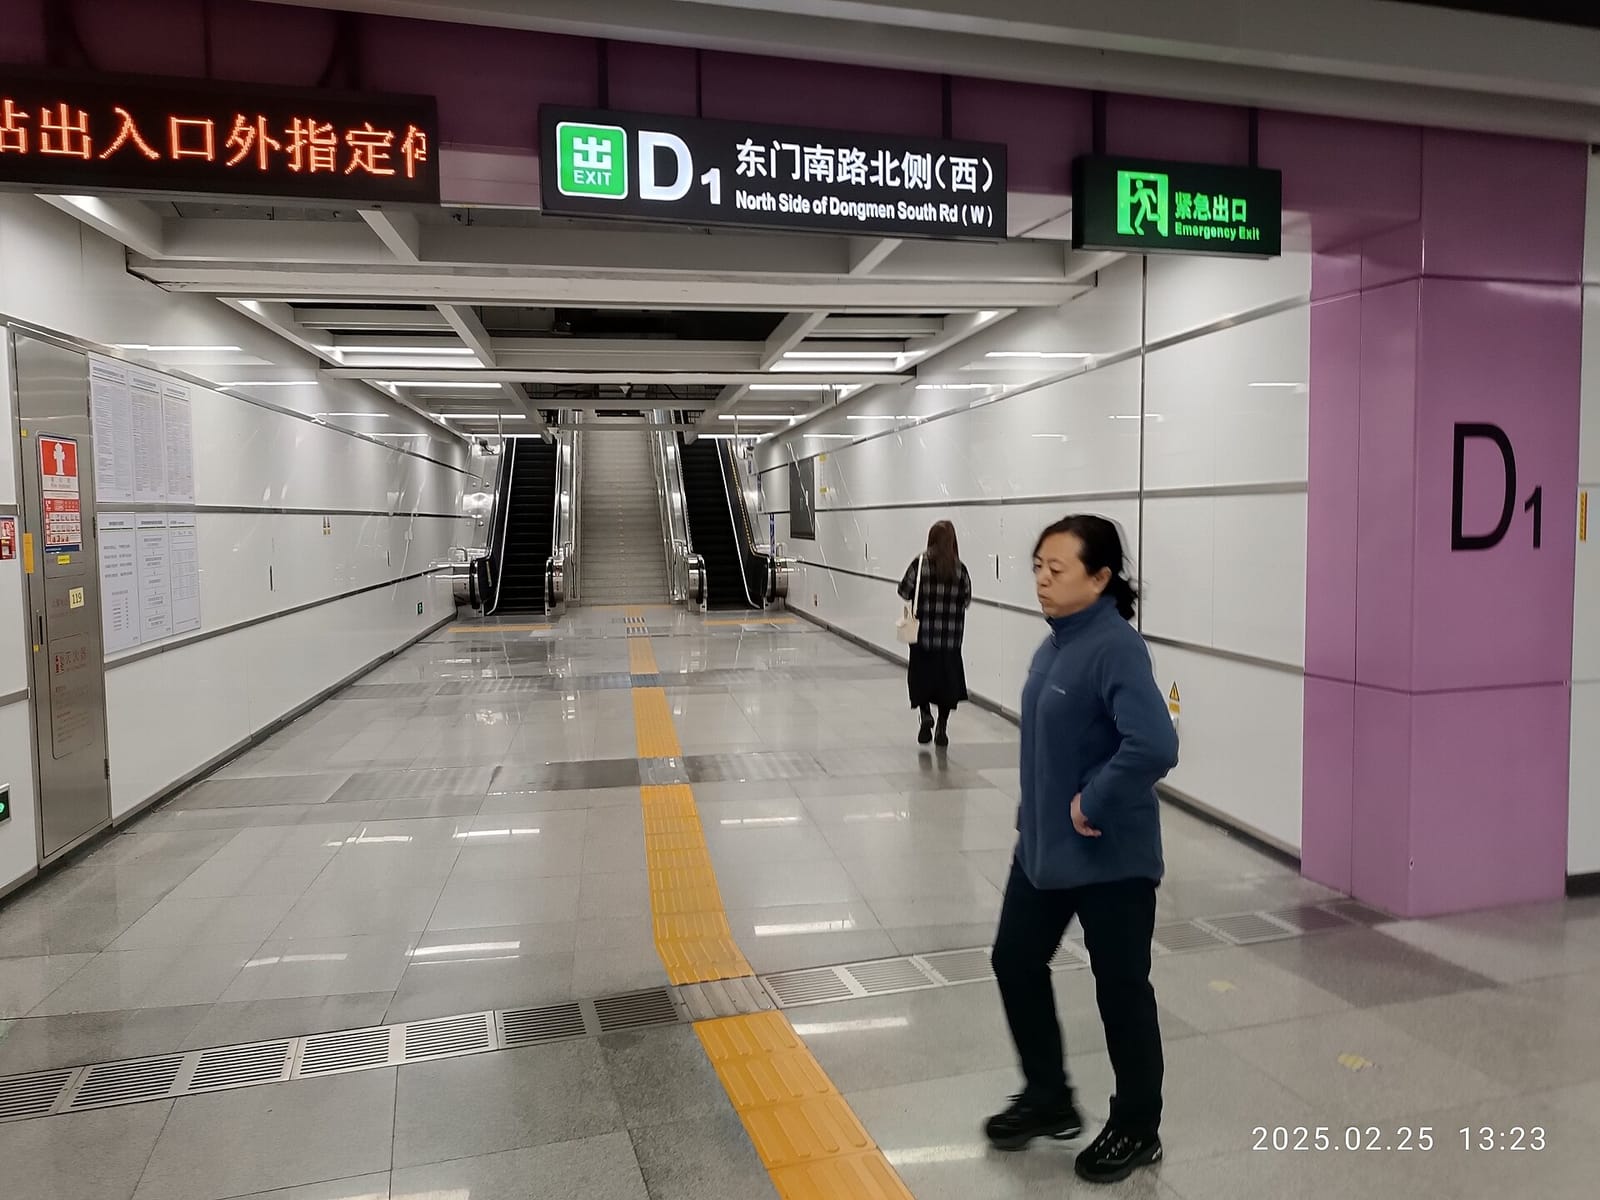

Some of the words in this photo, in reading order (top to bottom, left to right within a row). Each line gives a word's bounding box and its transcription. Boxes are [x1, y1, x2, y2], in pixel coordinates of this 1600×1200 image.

[572, 136, 612, 170] 出
[735, 138, 993, 193] 东门南路北侧(西)
[573, 169, 612, 187] EXIT
[735, 190, 777, 212] North
[778, 193, 810, 214] Side
[812, 197, 829, 215] of
[829, 197, 895, 221] Dongmen
[897, 203, 937, 222] South
[939, 204, 958, 222] Rd
[1175, 191, 1247, 223] 紧急出口
[1174, 222, 1236, 241] Emergency
[1238, 226, 1260, 241] Exit
[1451, 421, 1542, 552] D1
[71, 592, 82, 604] 119
